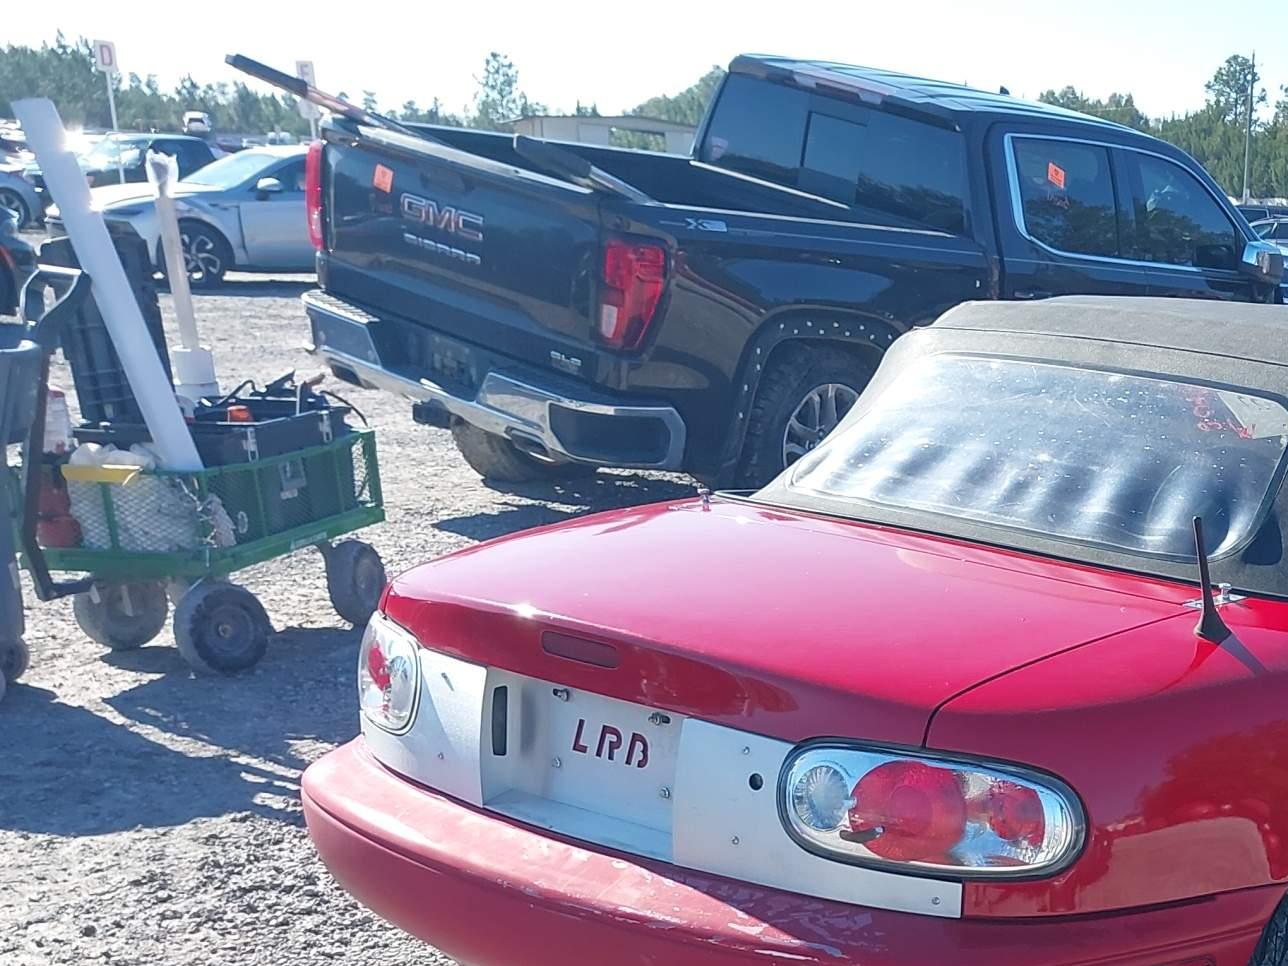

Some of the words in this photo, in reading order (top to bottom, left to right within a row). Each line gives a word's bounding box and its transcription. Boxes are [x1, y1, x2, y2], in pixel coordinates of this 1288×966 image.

[100, 44, 113, 66] D
[401, 192, 484, 241] GMC
[572, 718, 649, 769] LRB
